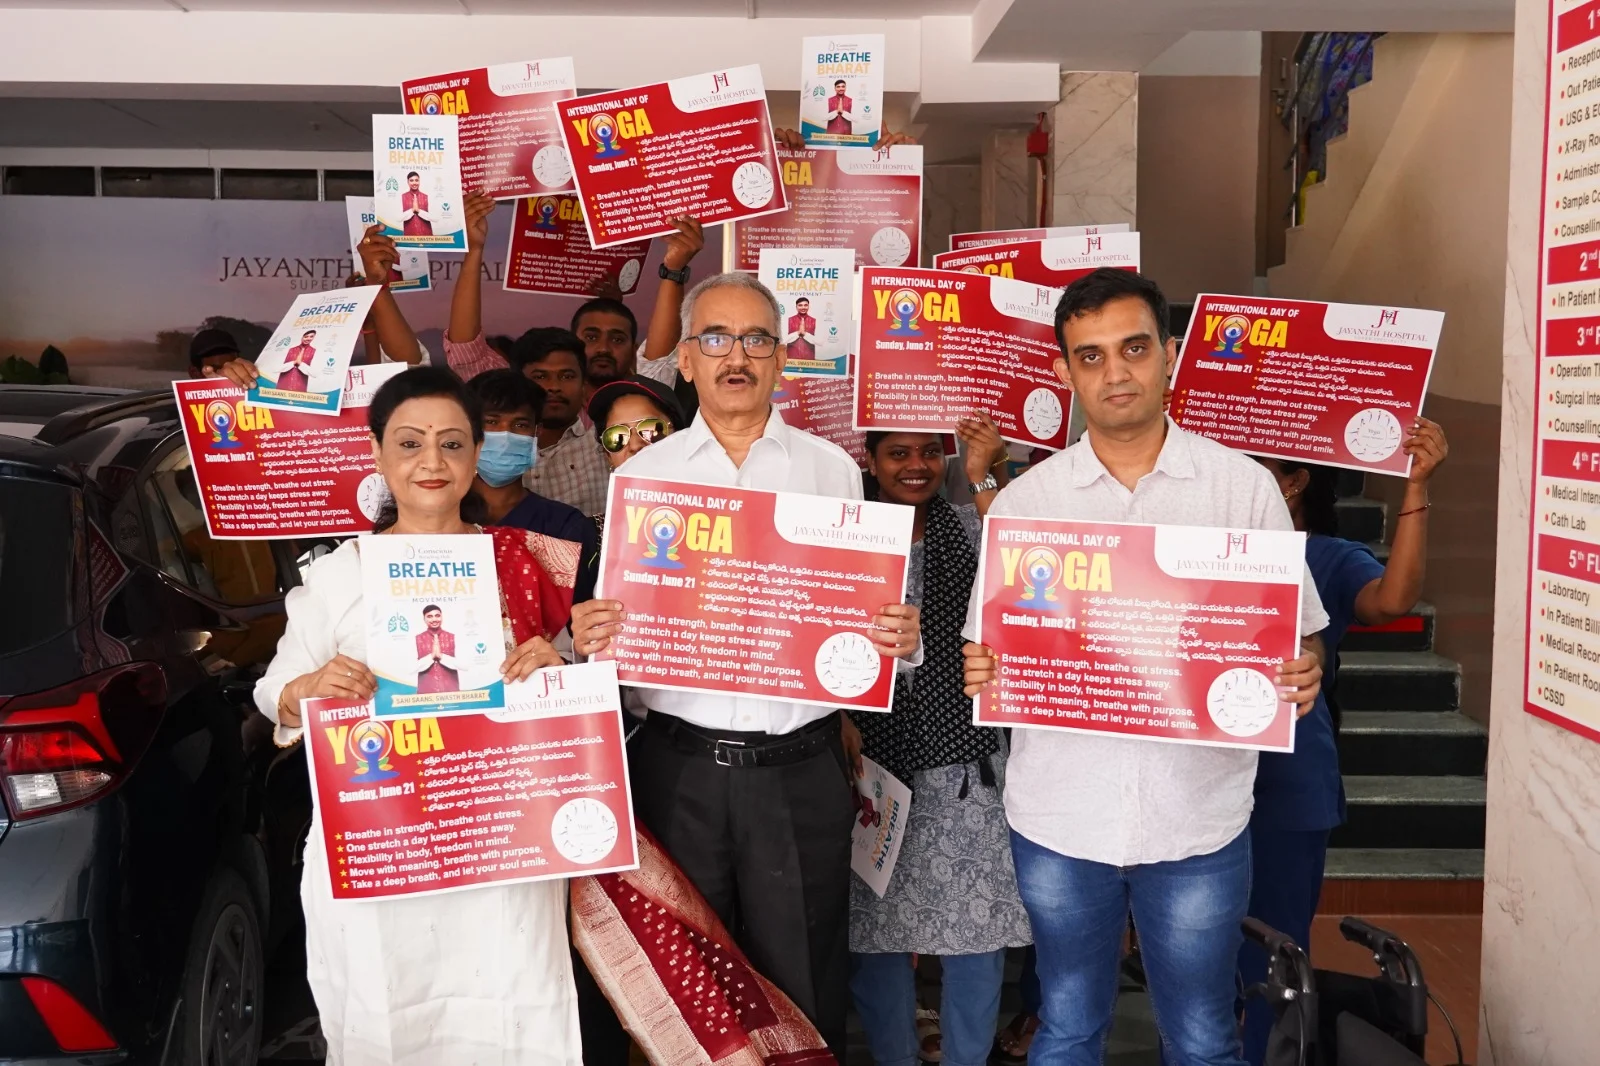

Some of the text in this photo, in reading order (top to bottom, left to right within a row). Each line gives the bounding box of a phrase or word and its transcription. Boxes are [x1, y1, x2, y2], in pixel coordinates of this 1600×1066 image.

[818, 52, 871, 63] BREATHE
[817, 63, 870, 75] BHARAT
[1567, 83, 1581, 98] Out
[567, 94, 649, 116] INTERNATIONAL DAY OF
[1566, 106, 1590, 126] USG &
[572, 106, 653, 147] YOGA
[389, 137, 444, 150] BREATHE
[1565, 138, 1586, 154] X-Ray
[389, 151, 444, 164] BHARAT
[587, 157, 637, 174] Sunday, June 21
[1562, 192, 1589, 210] Sample
[942, 250, 1020, 269] INTERNATIONAL DAY OF
[1580, 249, 1597, 271] 2nd
[777, 268, 839, 279] BREATHE
[290, 280, 339, 291] SUPER
[776, 280, 838, 291] BHARAT
[871, 276, 966, 290] INTERNATIONAL DAY OF
[873, 289, 961, 323] YOGA
[1558, 290, 1596, 307] In Patient
[300, 303, 358, 317] BREATHE
[1205, 302, 1299, 317] INTERNATIONAL DAY OF
[293, 313, 352, 327] BHARAT
[1198, 313, 1292, 348] YOGA
[1577, 327, 1593, 346] 3rd
[874, 340, 933, 350] Sunday, June 21
[1194, 359, 1252, 373] Sunday, June 21
[1556, 364, 1591, 380] Operation
[185, 388, 245, 400] INTERNATIONAL
[1555, 390, 1584, 408] Surgical
[203, 451, 254, 463] Sunday, June 21
[1573, 452, 1588, 470] 4th
[623, 488, 743, 512] INTERNATIONAL DAY OF
[1552, 484, 1578, 502] Medical
[621, 503, 736, 555] YOGA
[1551, 512, 1586, 530] Cath Lab
[997, 529, 1120, 547] INTERNATIONAL DAY OF
[1569, 549, 1584, 568] 5th
[388, 562, 476, 578] BREATHE
[998, 545, 1114, 593] YOGA
[390, 578, 476, 596] BHARAT
[622, 570, 695, 588] Sunday, June 21
[1548, 580, 1590, 606] Laboratory
[1001, 612, 1075, 628] Sunday, June 21
[1547, 607, 1553, 621] In
[1556, 609, 1582, 629] Patient
[1546, 634, 1574, 654] Medical
[1001, 653, 1182, 676] Breathe in strength, breathe out stress.
[1545, 660, 1551, 674] In
[1554, 663, 1580, 685] Patient
[1001, 666, 1019, 675] One
[1022, 668, 1054, 678] stretch
[1064, 671, 1081, 682] day
[1083, 673, 1111, 685] keeps
[1113, 676, 1142, 686] stress
[1144, 680, 1171, 690] away.
[436, 694, 460, 702] SWASTH
[462, 692, 485, 700] BHARAT
[1001, 678, 1163, 700] Flexibility in body, freedom in mind.
[1544, 687, 1564, 706] CSSD
[1000, 691, 1195, 717] Move with meaning, breathe with purpose.
[1000, 703, 1021, 713] Take
[1031, 706, 1054, 717] deep
[1056, 708, 1088, 720] breath,
[1090, 711, 1107, 721] and
[1110, 713, 1121, 722] let
[1124, 716, 1145, 726] your
[1147, 716, 1168, 726] soul
[1170, 719, 1199, 729] smile.
[326, 717, 445, 765] YOGA
[338, 782, 414, 804] Sunday, June 21
[875, 800, 899, 872] BREATHE
